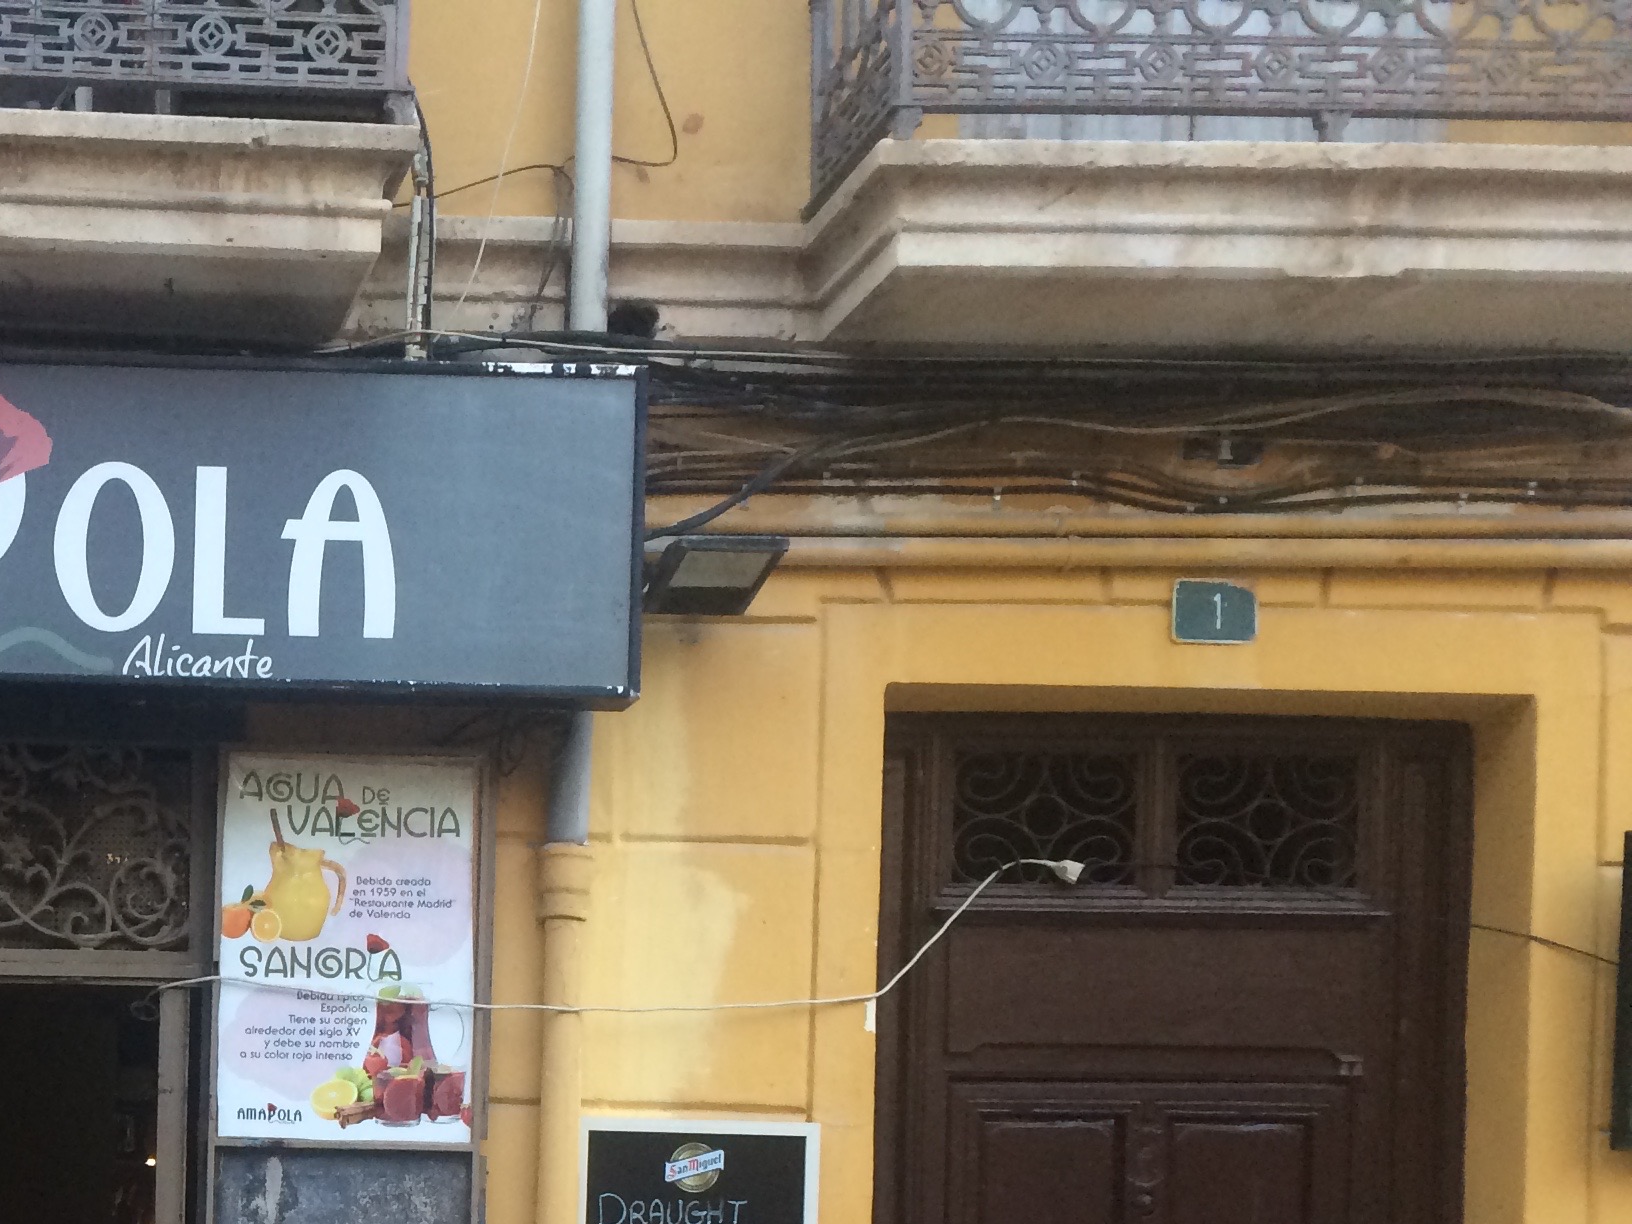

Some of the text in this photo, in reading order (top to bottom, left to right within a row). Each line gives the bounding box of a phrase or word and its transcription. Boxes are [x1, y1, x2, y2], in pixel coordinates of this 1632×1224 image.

[1213, 592, 1222, 630] 1
[122, 632, 274, 680] Alicante
[239, 769, 390, 805] AGUA DE
[287, 805, 460, 838] VALENCIA
[356, 876, 431, 887] Bebida creada
[353, 888, 426, 898] en 1959 en el
[349, 909, 411, 919] de Valencia
[321, 1003, 368, 1014] Española
[288, 1014, 367, 1027] Tiene su origen
[245, 1026, 360, 1038] alrededor del siglo XV
[264, 1038, 360, 1049] y debe su nombre
[264, 1050, 289, 1059] color
[293, 1051, 312, 1061] rojo
[316, 1051, 352, 1060] intenso
[237, 1107, 302, 1123] AMAPOLA
